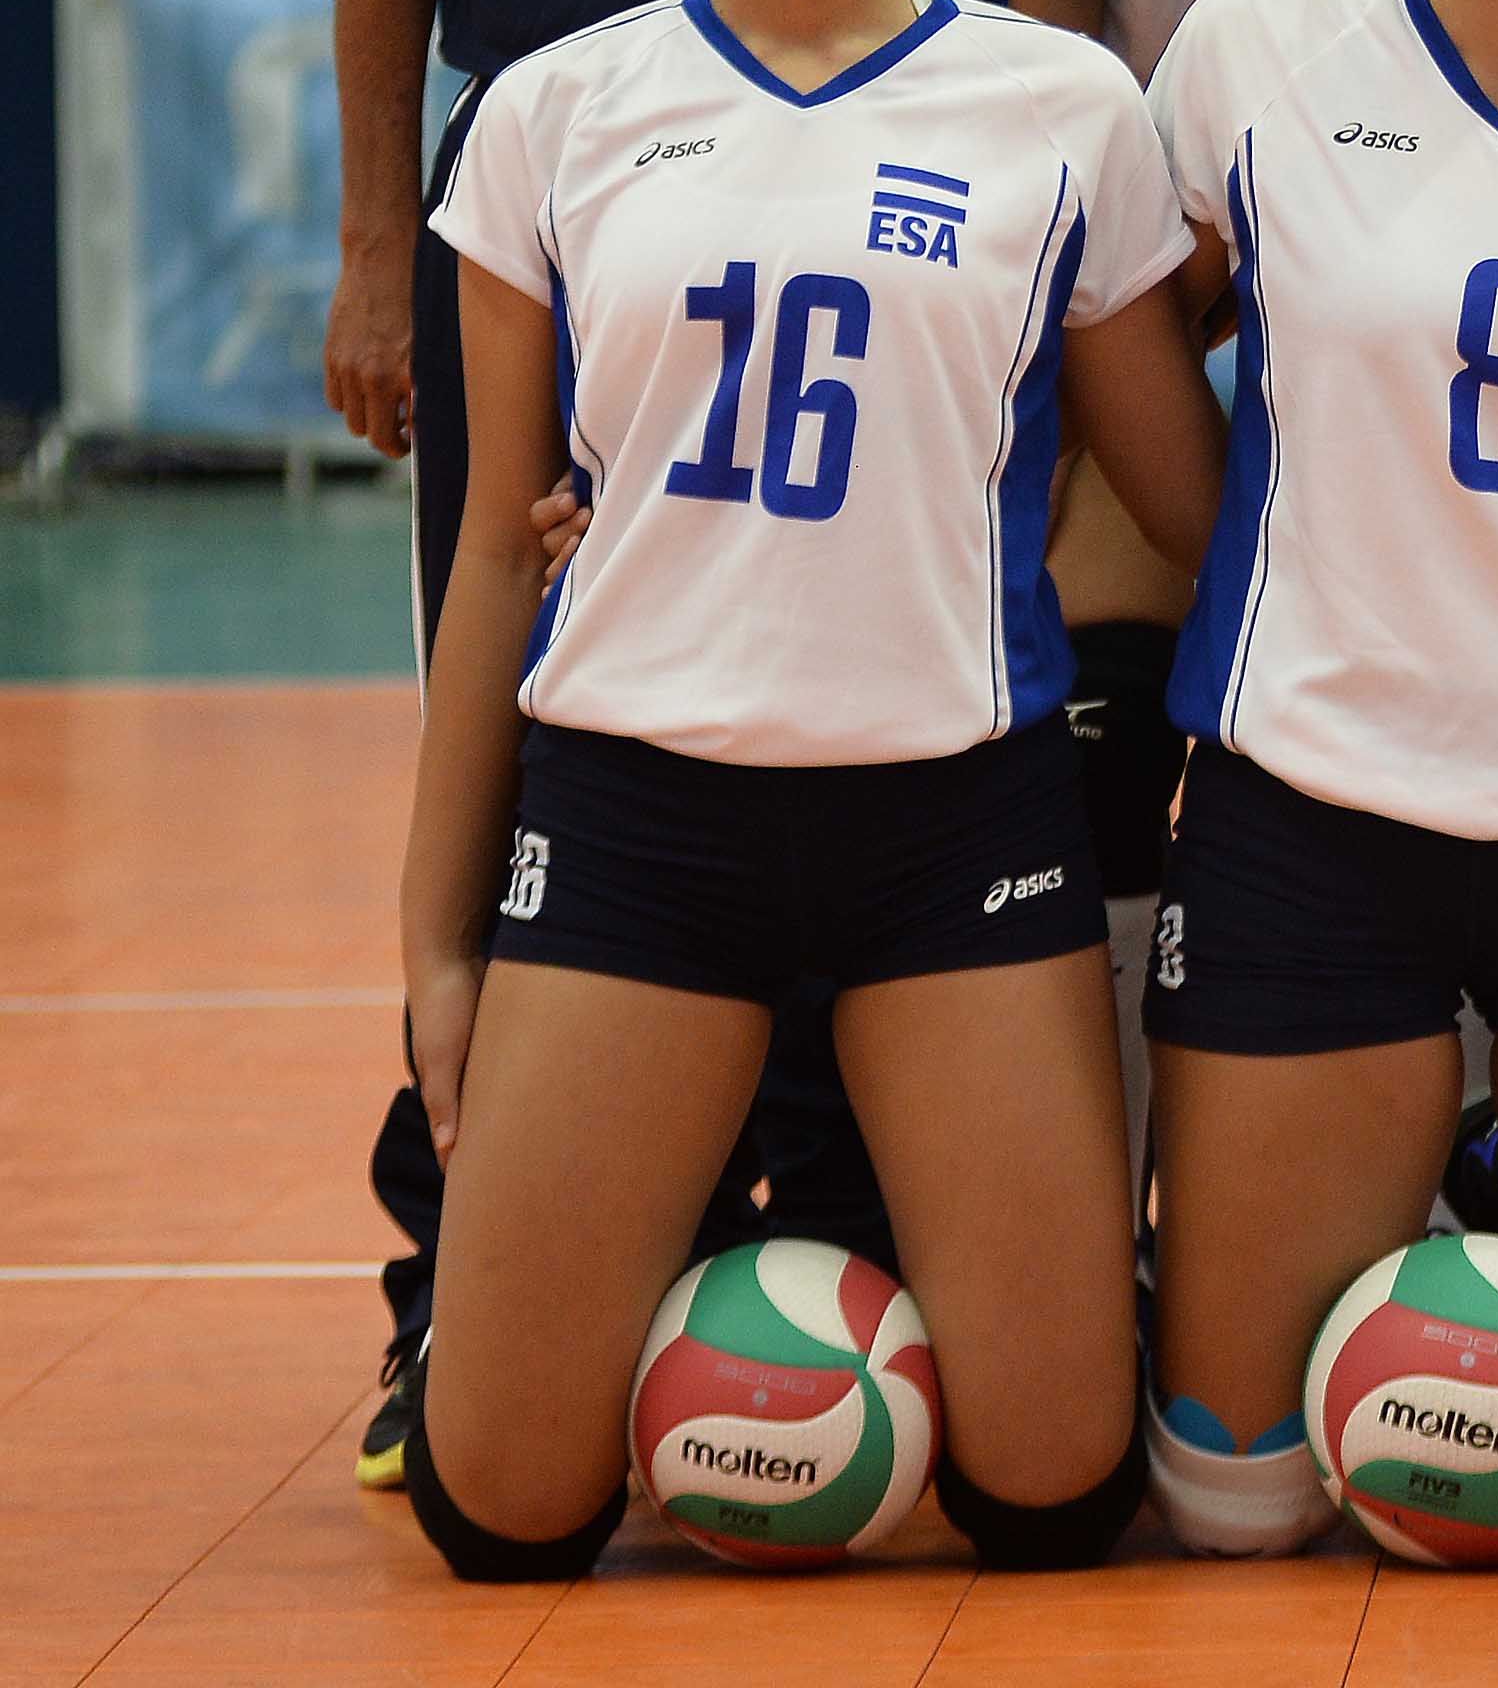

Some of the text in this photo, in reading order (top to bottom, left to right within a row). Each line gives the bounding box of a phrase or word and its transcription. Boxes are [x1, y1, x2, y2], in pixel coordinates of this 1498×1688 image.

[660, 135, 716, 161] asics
[1361, 127, 1420, 154] asics
[865, 212, 960, 270] ESA
[663, 260, 871, 523] 16
[500, 825, 551, 921] 16
[1013, 866, 1065, 900] asics
[680, 1438, 818, 1486] molten
